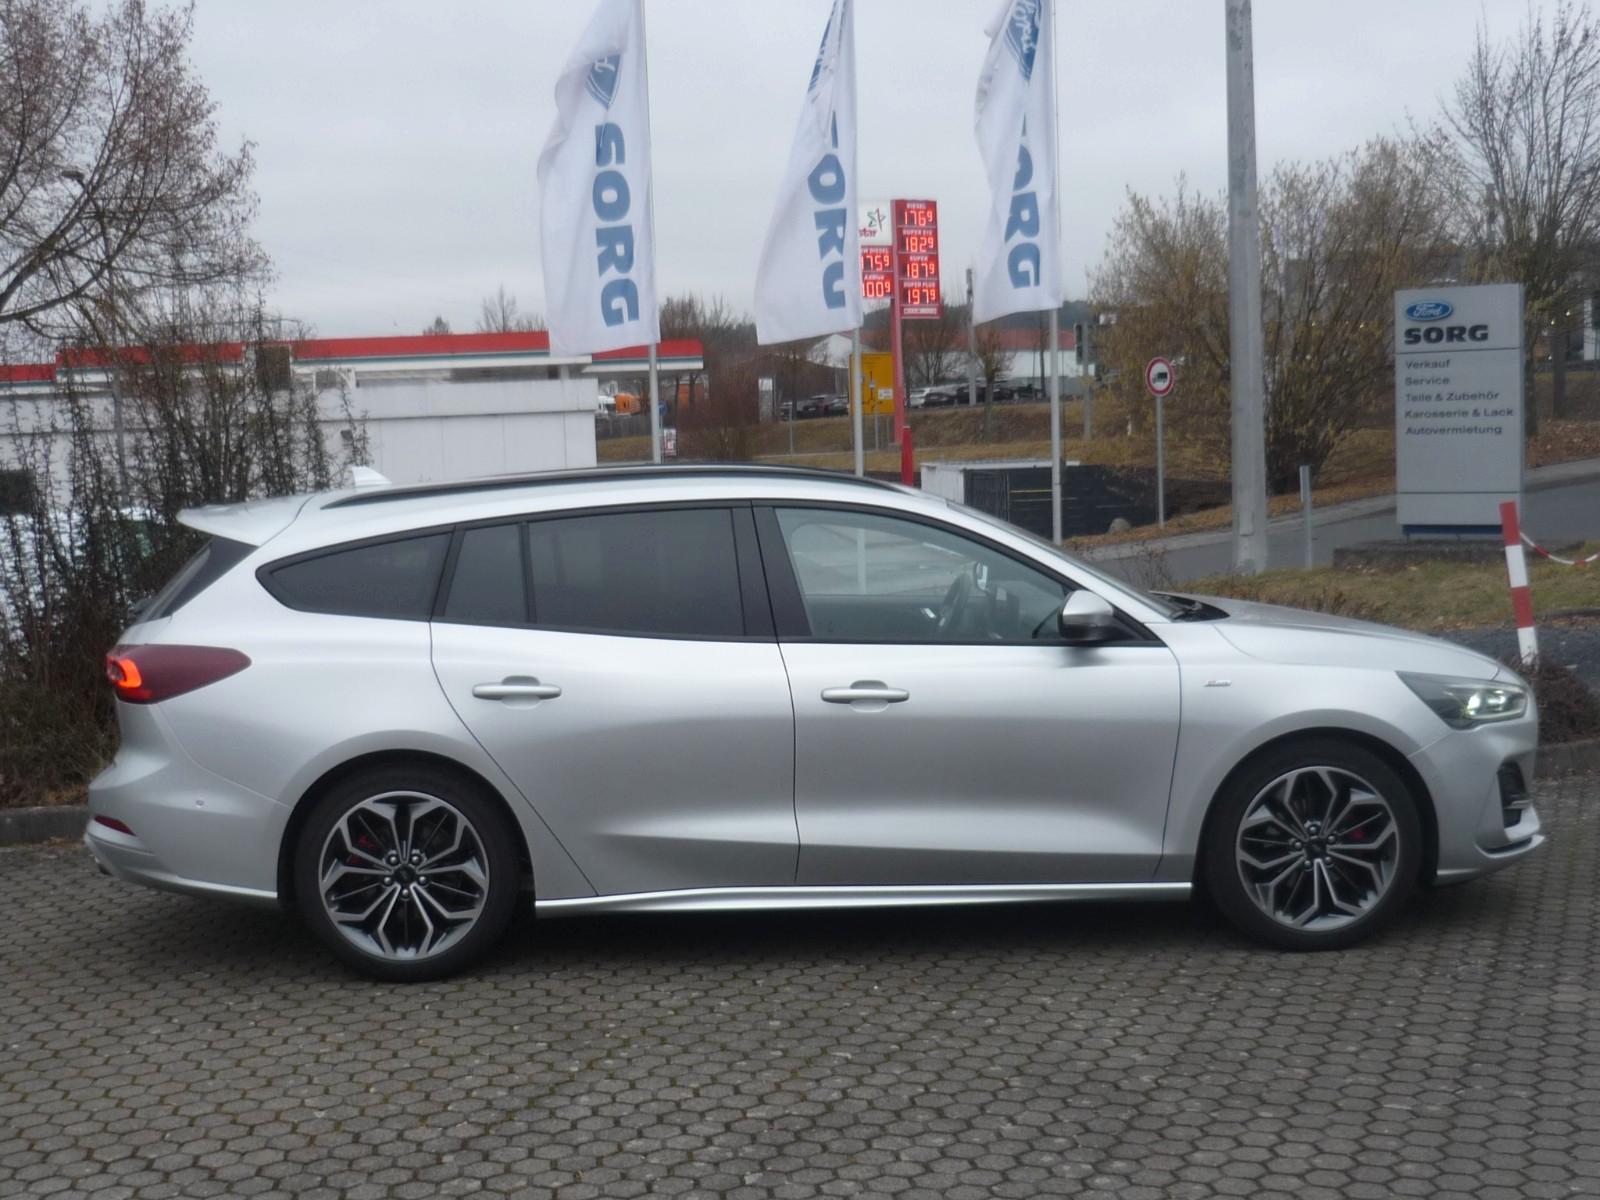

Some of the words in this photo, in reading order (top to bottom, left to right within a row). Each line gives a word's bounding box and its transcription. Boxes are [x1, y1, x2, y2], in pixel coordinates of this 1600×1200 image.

[807, 110, 847, 309] ORG
[592, 122, 640, 327] SORG
[1413, 304, 1442, 317] Ford
[1404, 325, 1489, 345] SORG
[1405, 360, 1450, 369] Verkauf
[1405, 377, 1450, 386] Service
[1406, 394, 1432, 402] Teile
[1434, 393, 1443, 401] &
[1446, 391, 1499, 400] Zubehör
[1404, 409, 1468, 418] Karosserie
[1472, 408, 1480, 418] &
[1484, 408, 1514, 416] Lack
[1406, 425, 1502, 435] Autovermietung
